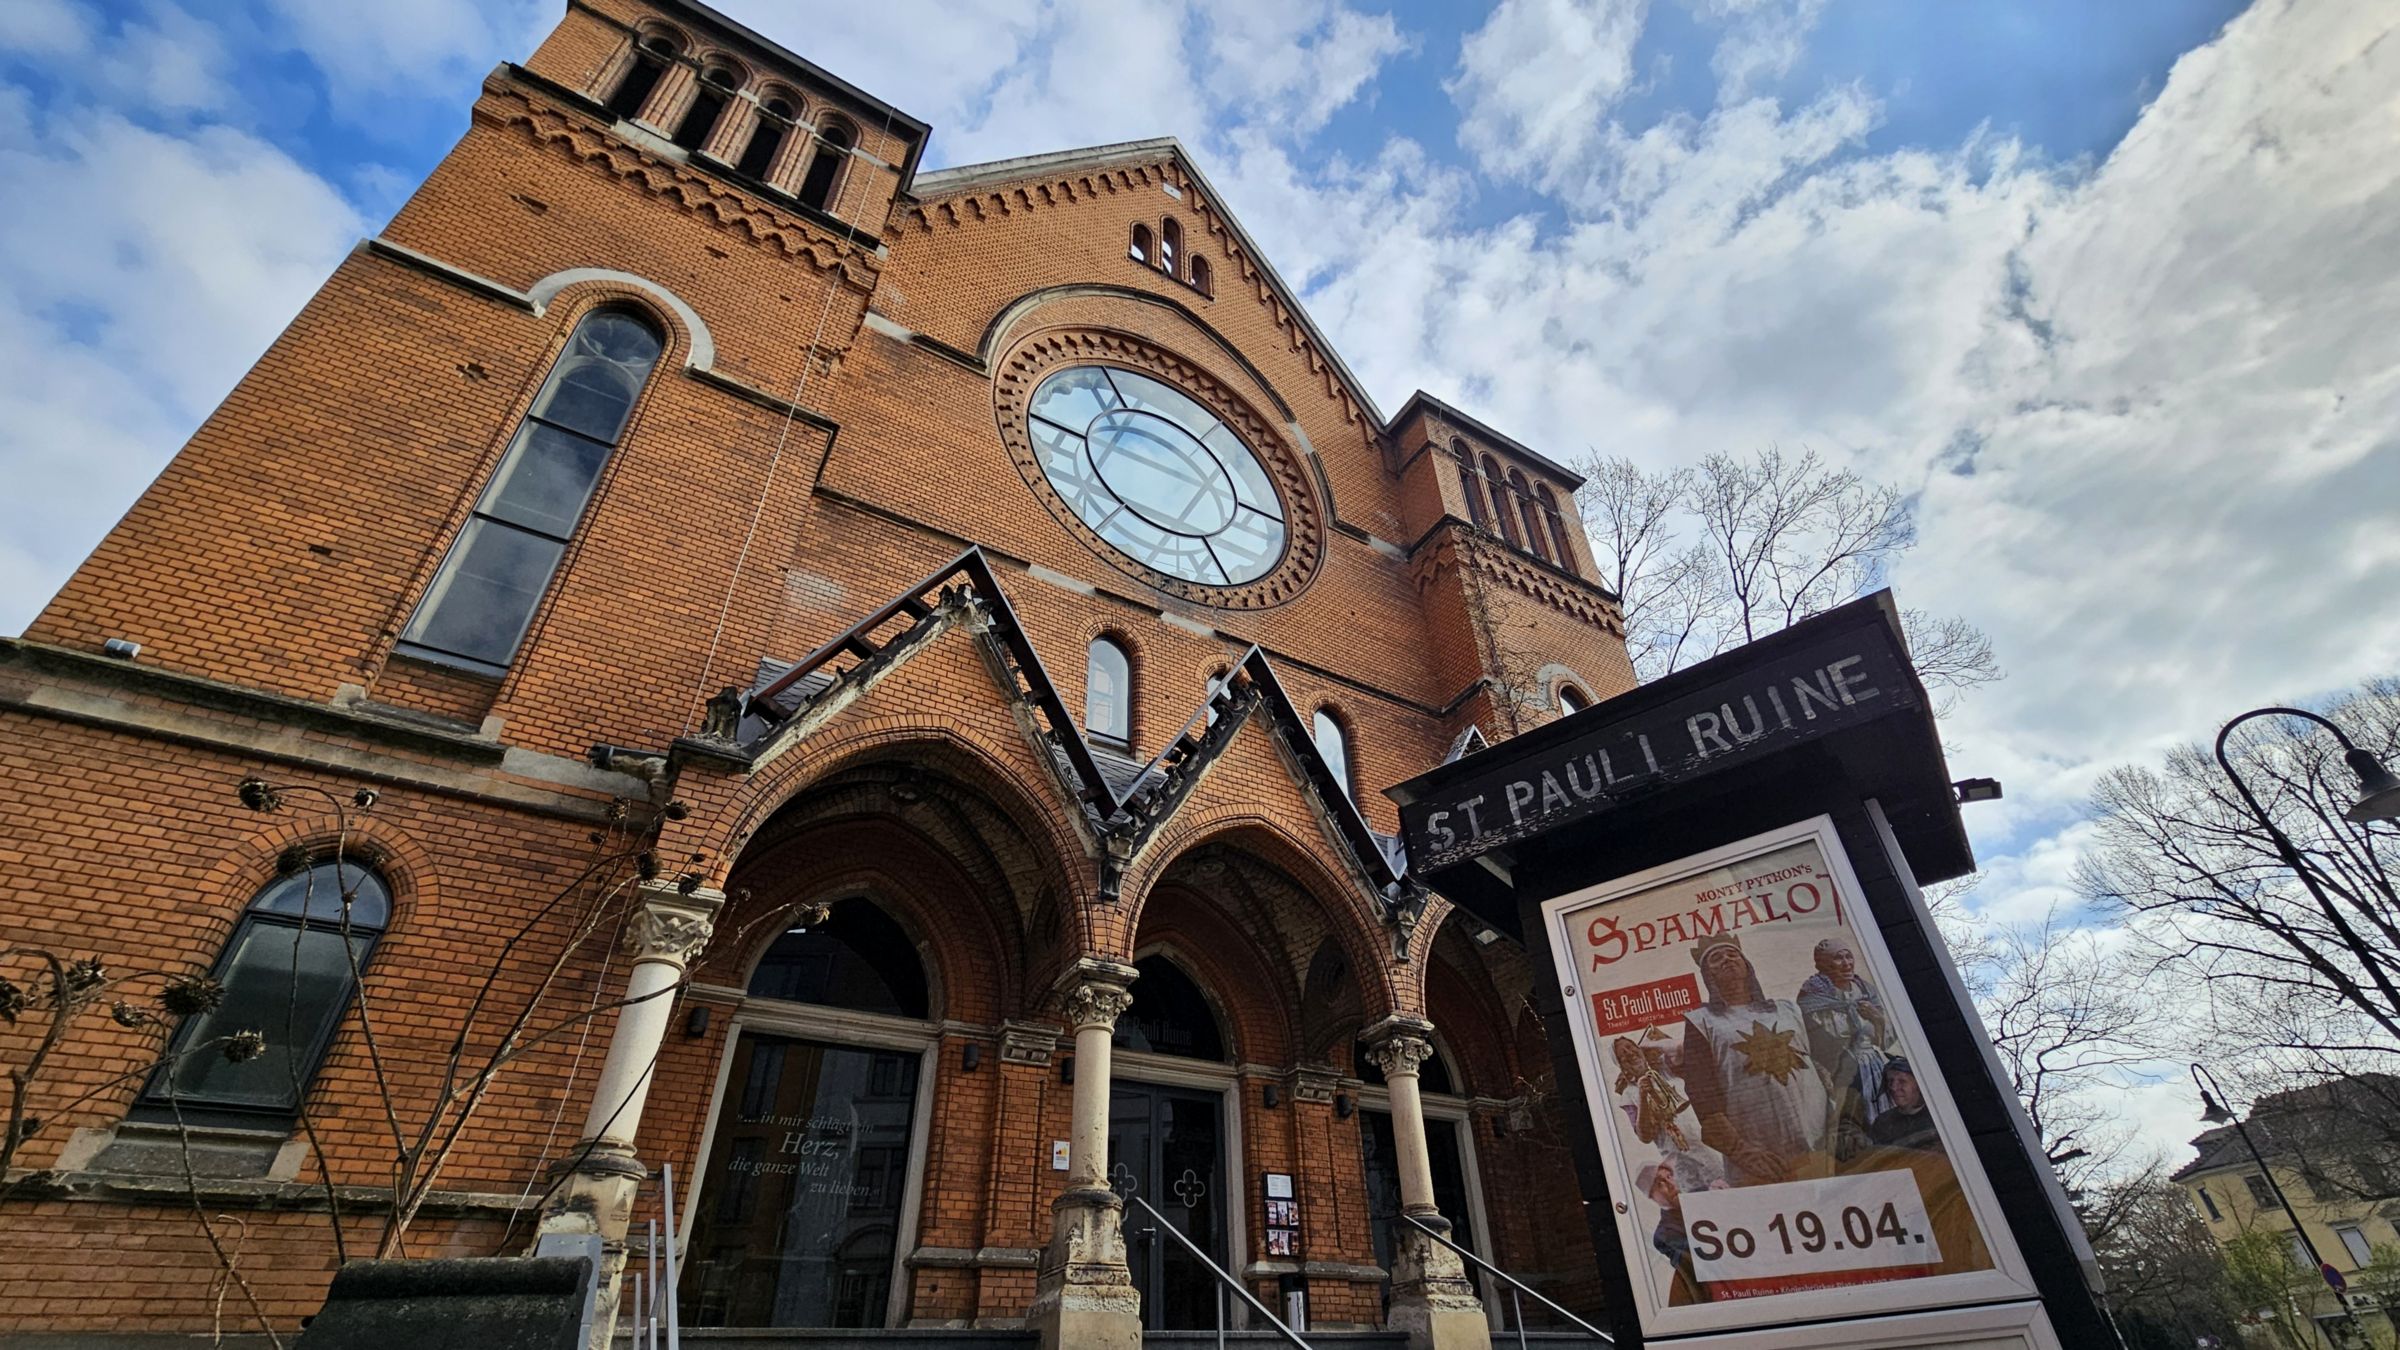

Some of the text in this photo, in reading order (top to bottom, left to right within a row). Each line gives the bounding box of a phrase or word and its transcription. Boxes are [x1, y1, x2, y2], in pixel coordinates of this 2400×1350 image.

[1506, 734, 1660, 825] PAULI
[1686, 655, 1880, 758] RUINE
[1695, 882, 1742, 904] MONTY
[1602, 985, 1690, 1020] St. Pauli Ruine
[760, 1111, 775, 1124] in
[778, 1115, 804, 1126] mir
[778, 1131, 839, 1160] Herz,
[728, 1156, 830, 1177] die ganze Welt
[809, 1183, 827, 1193] zu
[1690, 1201, 1925, 1261] So 19.04.
